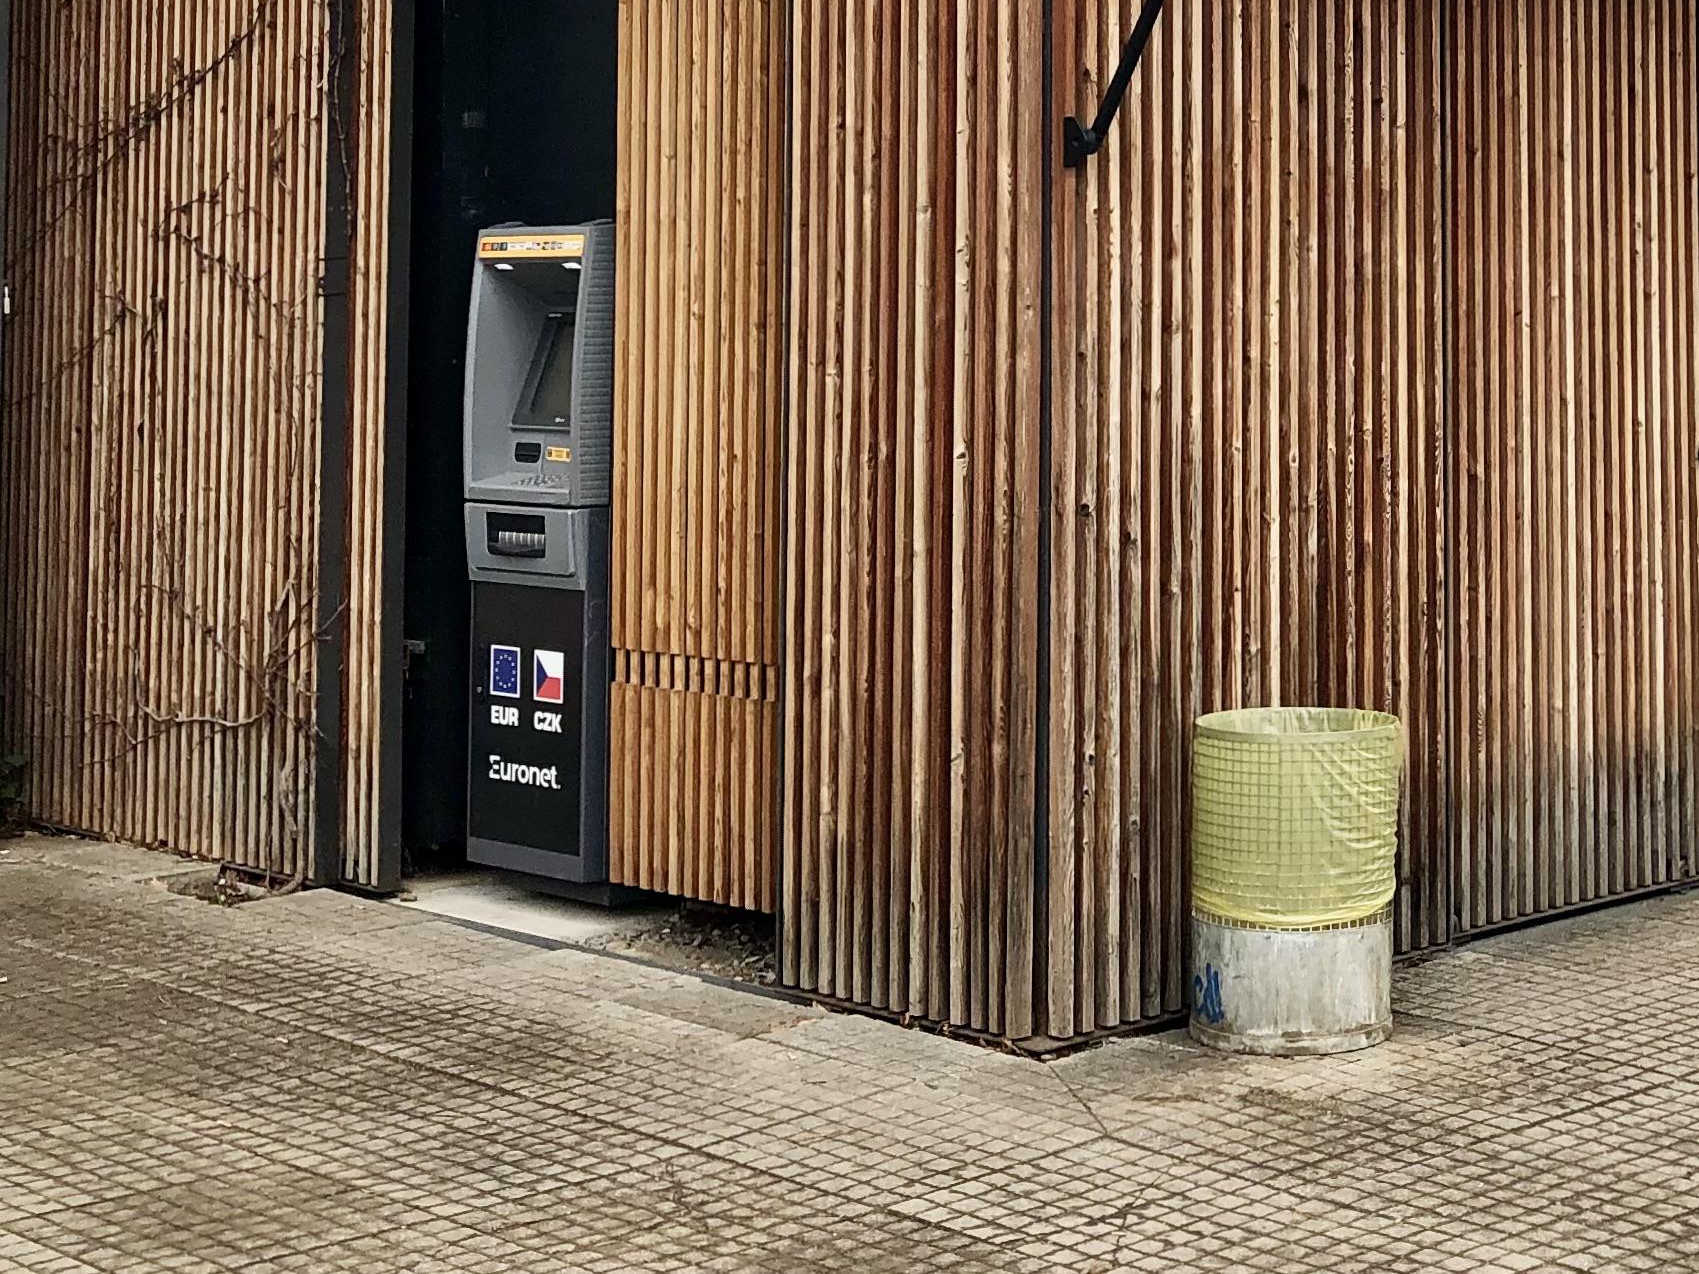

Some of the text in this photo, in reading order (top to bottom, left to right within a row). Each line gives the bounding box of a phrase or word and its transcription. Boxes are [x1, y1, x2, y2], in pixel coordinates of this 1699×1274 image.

[490, 705, 563, 733] EUR CZK
[489, 755, 561, 789] Euronet
